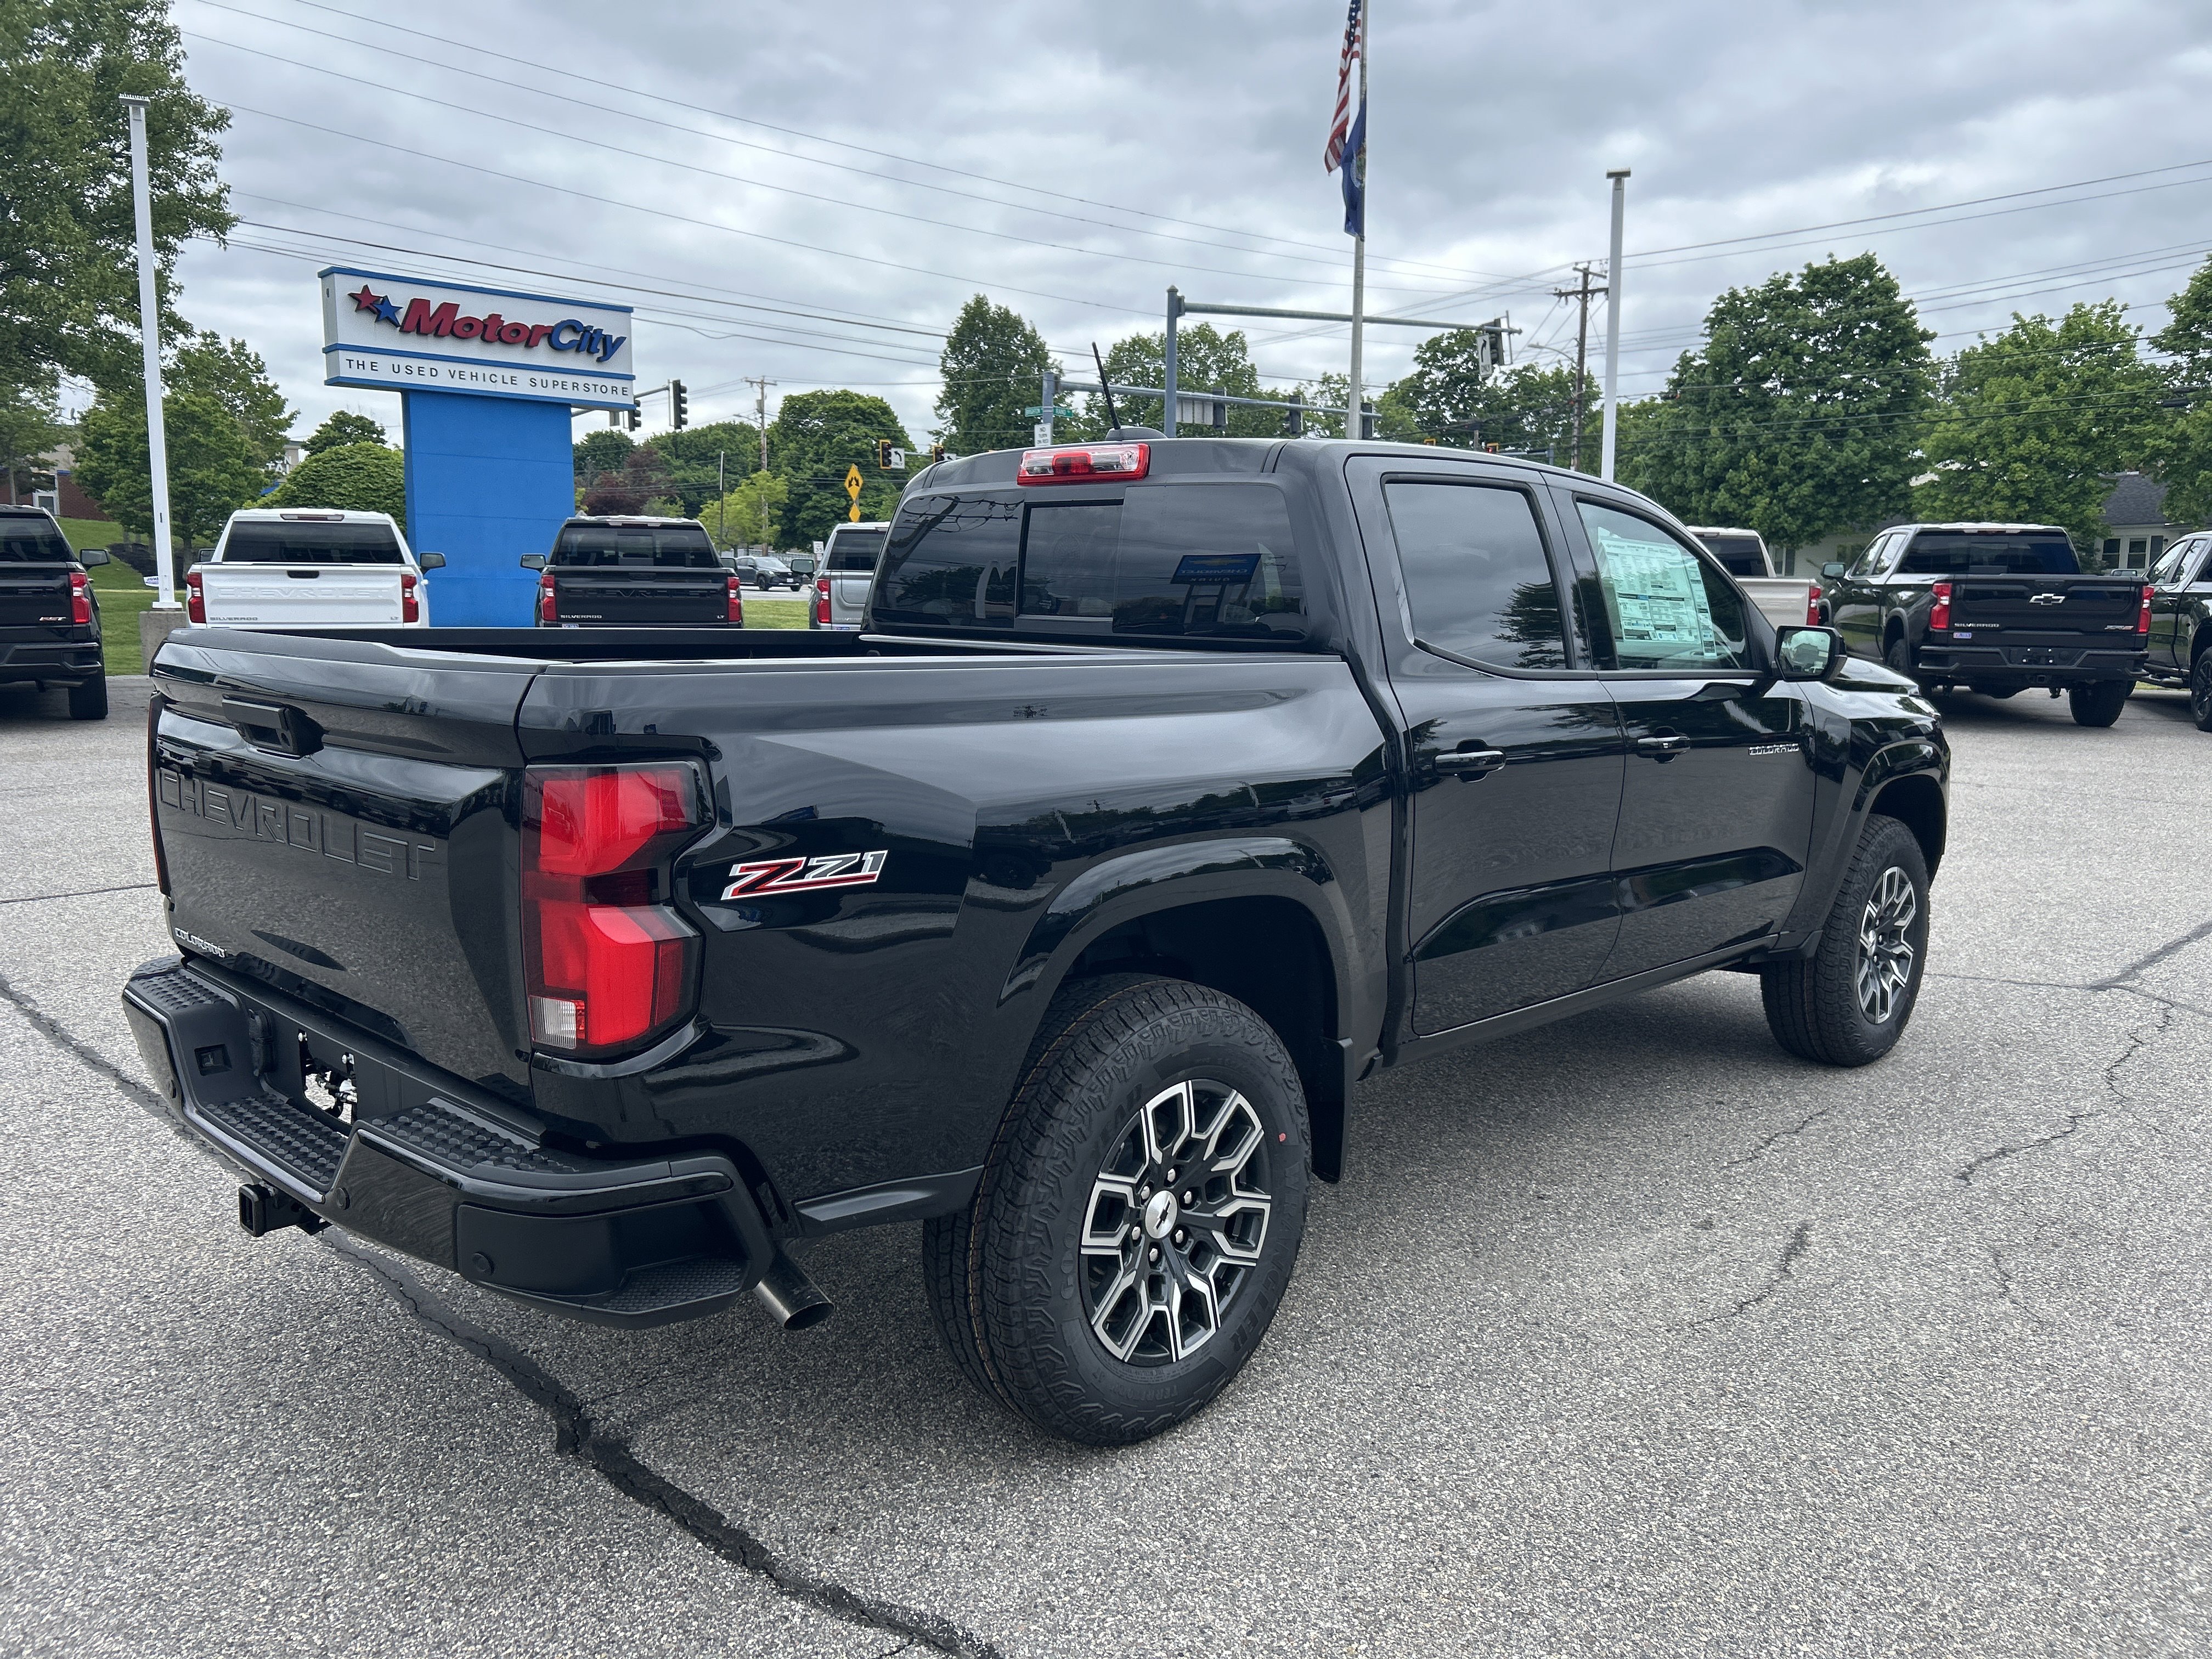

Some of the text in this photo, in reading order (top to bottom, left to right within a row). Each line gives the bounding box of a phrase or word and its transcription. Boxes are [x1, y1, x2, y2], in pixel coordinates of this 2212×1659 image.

[399, 297, 627, 362] MotorCity
[346, 359, 629, 396] THE USED VEHICLE SUPERSTORE
[1748, 743, 1799, 756] COLORADO
[159, 767, 436, 881] CHEVROLET
[720, 850, 888, 901] Z71
[174, 927, 227, 958] COLORADO
[1227, 1161, 1300, 1353] WRANGLER
